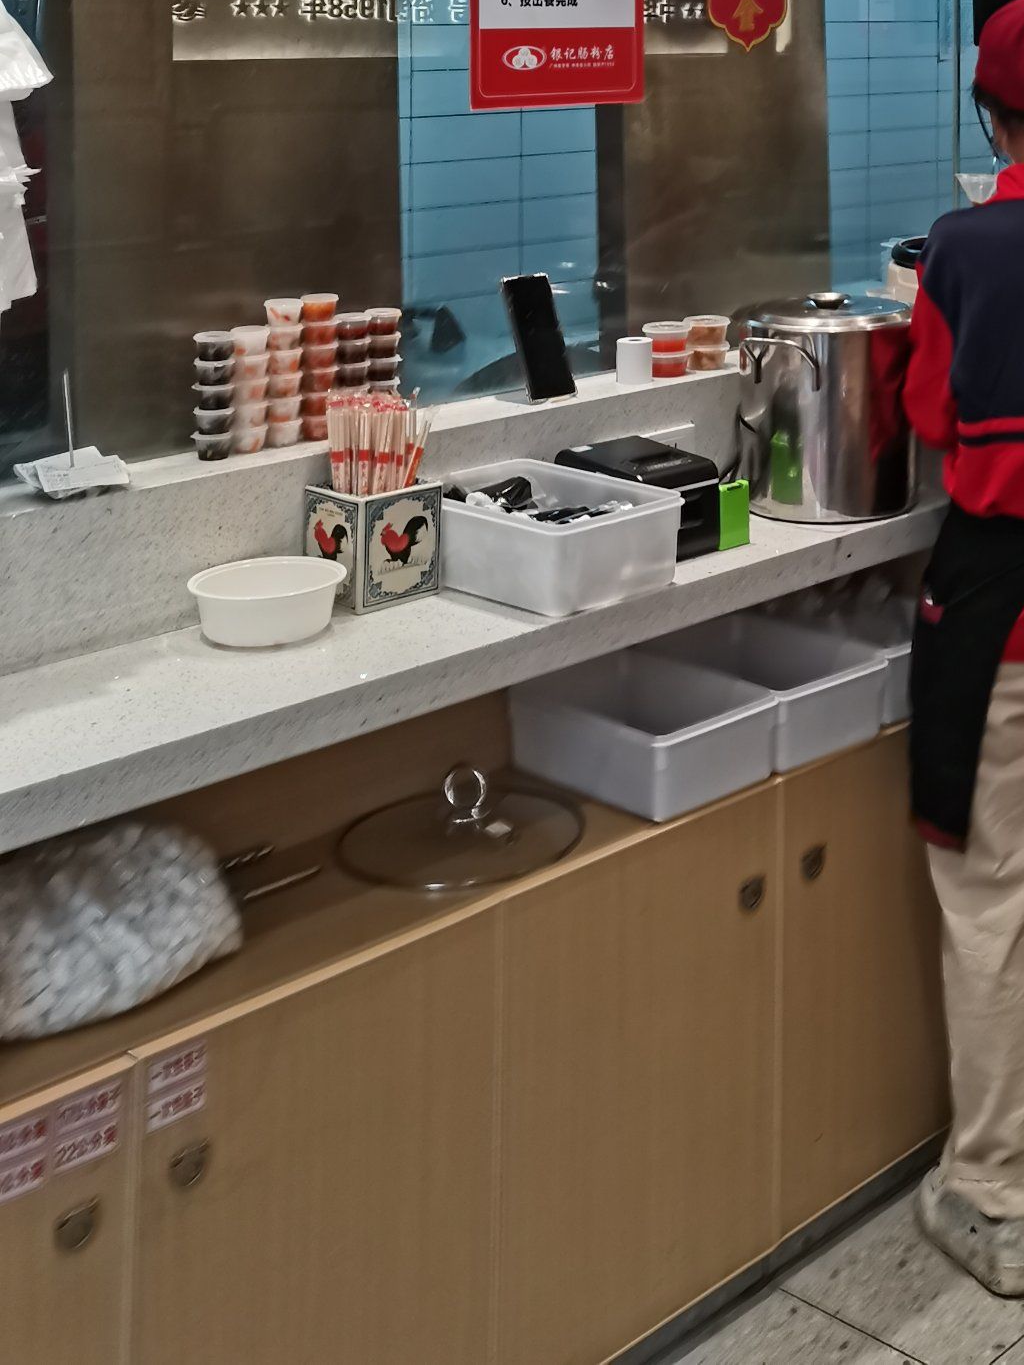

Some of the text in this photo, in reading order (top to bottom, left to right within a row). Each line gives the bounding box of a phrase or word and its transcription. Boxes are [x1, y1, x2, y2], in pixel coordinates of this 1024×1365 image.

[550, 44, 615, 61] 银记肠粉店
